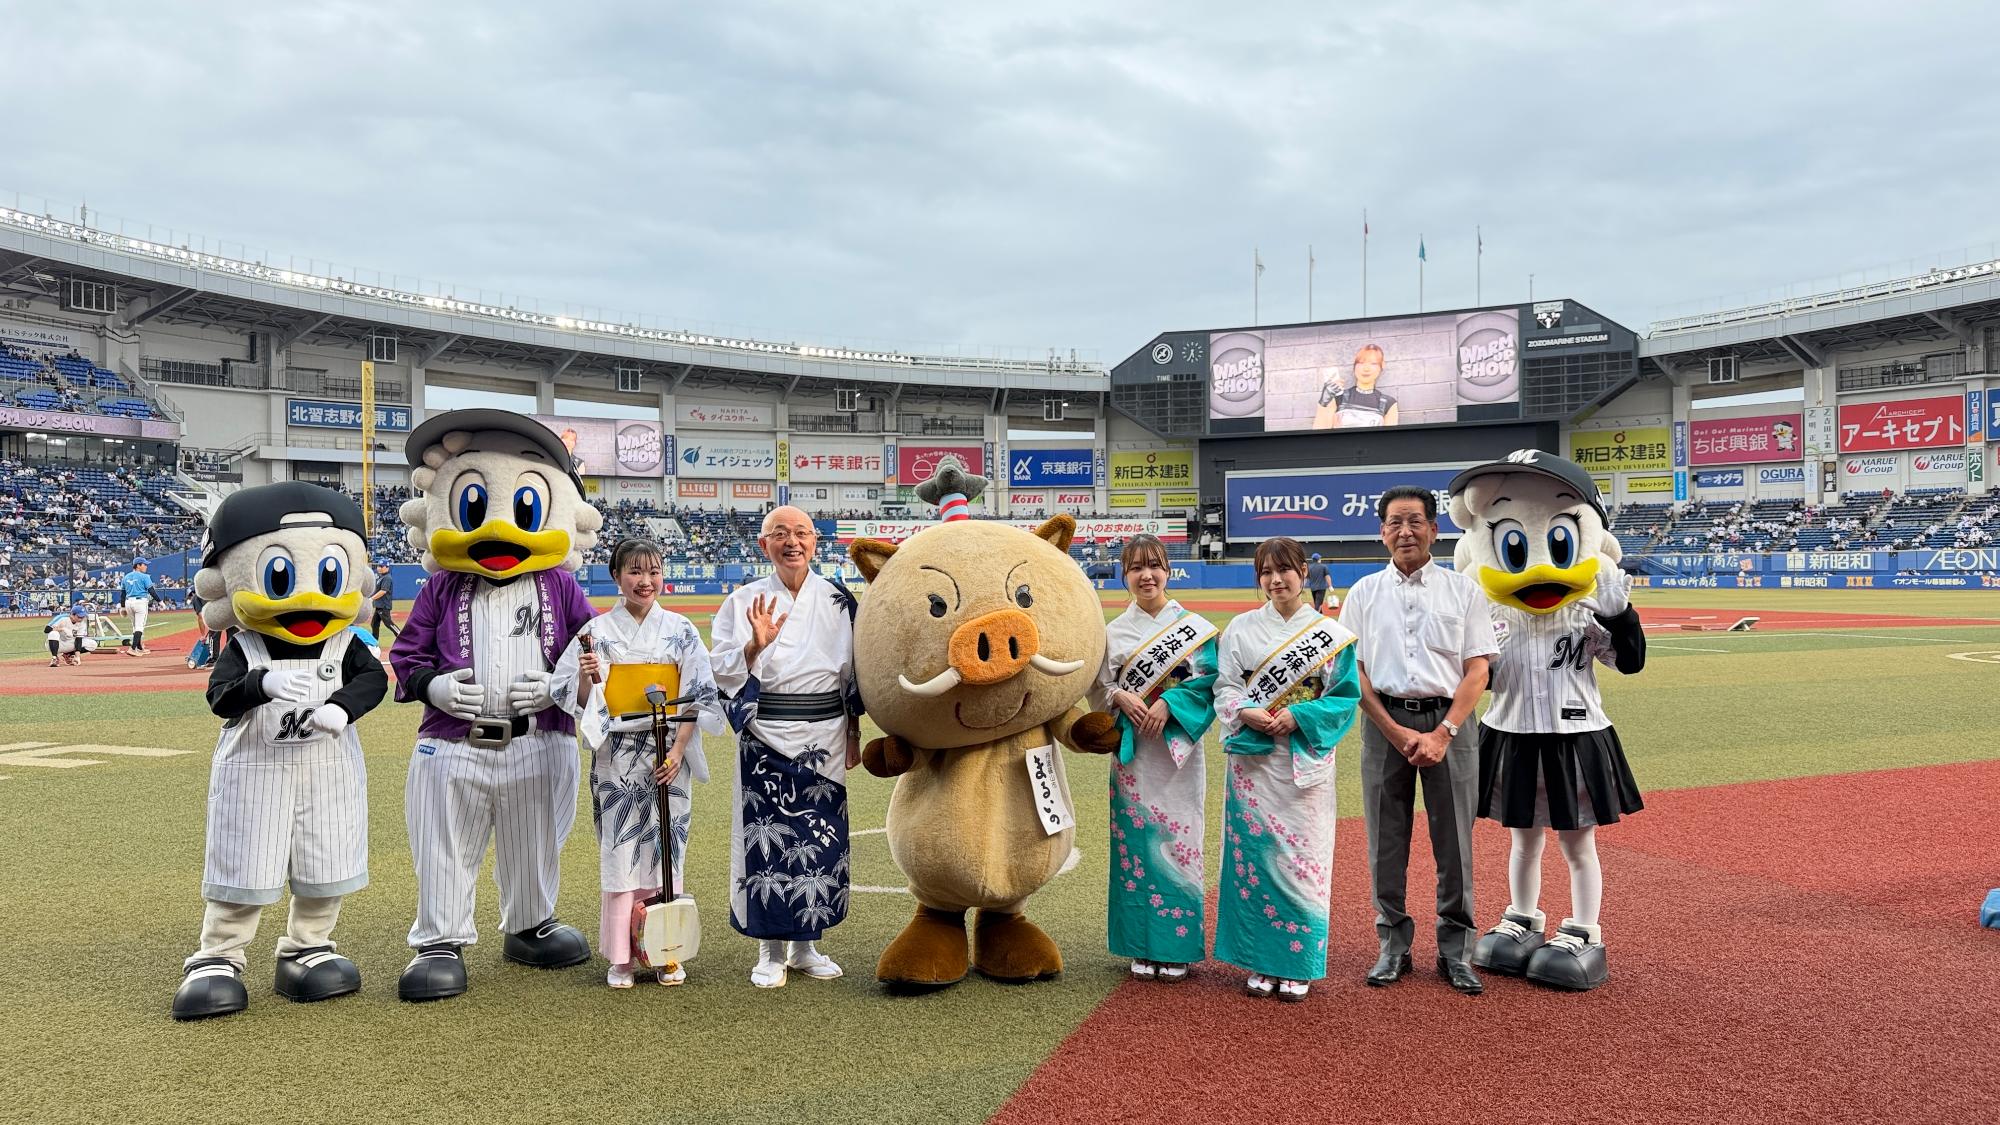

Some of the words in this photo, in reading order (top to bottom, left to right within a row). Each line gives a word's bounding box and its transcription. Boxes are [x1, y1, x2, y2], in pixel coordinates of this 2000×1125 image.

[1527, 337, 1575, 348] ZOZOMARINE
[1576, 334, 1609, 344] STADIUM
[1459, 334, 1513, 364] WARM
[1494, 350, 1515, 362] UP
[1212, 353, 1260, 381] WARM
[1245, 368, 1262, 380] UP
[1460, 360, 1515, 379] SHOW
[1213, 378, 1261, 394] SHOW
[26, 415, 46, 426] UP
[51, 416, 96, 431] SHOW
[711, 414, 759, 422] ダイユウホーム
[1842, 414, 1963, 447] アーキセプト
[616, 429, 660, 451] WARM
[645, 442, 661, 452] UP
[1693, 433, 1769, 455] ちば興銀
[618, 449, 661, 463] SHOW
[1574, 443, 1667, 463] 新日本建設
[1930, 453, 1966, 463] MARUE
[705, 455, 774, 468] エイジェック
[810, 455, 881, 470] 千葉銀行
[1040, 461, 1092, 475] 京葉銀行
[1624, 462, 1666, 470] DEVELOPER
[1861, 457, 1898, 466] MARUEI
[1933, 462, 1964, 471] Group
[1968, 453, 1983, 482] ホクト
[1114, 464, 1190, 479] 新日本建設
[1760, 468, 1805, 480] OGURA
[1863, 466, 1893, 474] Group
[1713, 473, 1743, 485] オグラ
[681, 483, 715, 492] B.I.TECH
[735, 484, 768, 493] B.I.TECH
[1241, 494, 1329, 513] MIZUHO
[1808, 552, 1871, 570] 新昭和
[674, 584, 696, 593] KOIKE
[1793, 577, 1828, 588] 新昭和
[458, 573, 475, 659] 丹波篠山観光協会
[508, 602, 541, 640] M
[1547, 632, 1592, 672] M
[274, 708, 316, 740] M
